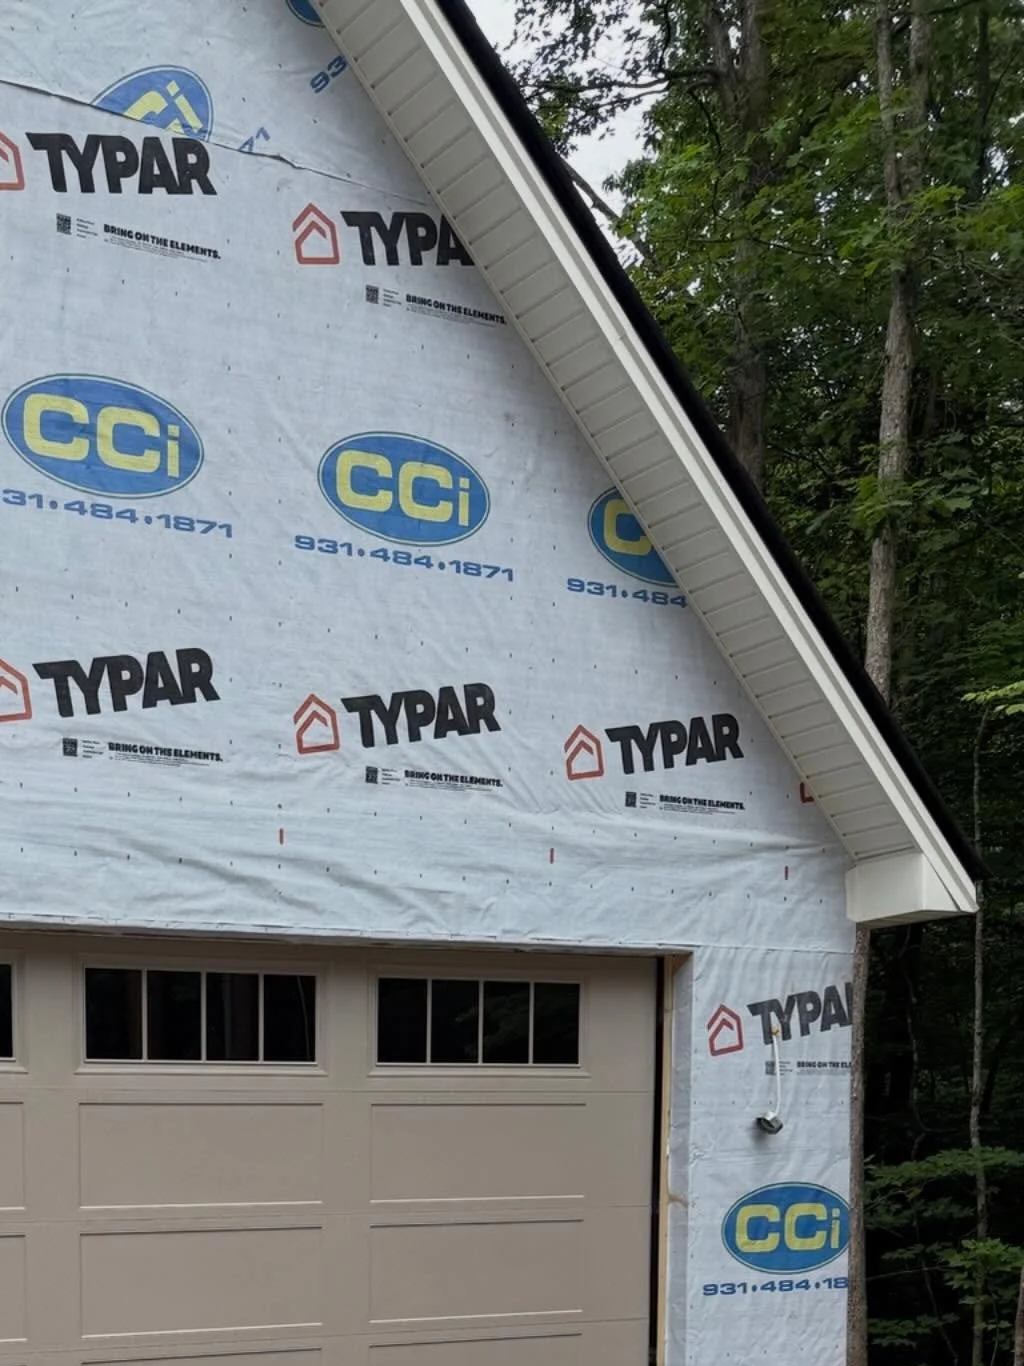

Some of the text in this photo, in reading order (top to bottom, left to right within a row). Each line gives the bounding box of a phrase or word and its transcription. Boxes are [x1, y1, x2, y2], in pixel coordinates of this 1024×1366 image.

[26, 131, 217, 196] TYPAR
[103, 223, 133, 239] BRING
[135, 231, 150, 243] ON
[151, 235, 169, 248] THE
[170, 239, 222, 260] ELEMENTS.
[406, 293, 432, 307] BRING
[433, 300, 446, 311] ON
[446, 303, 462, 314] THE
[463, 307, 507, 325] ELEMENTS.
[22, 393, 181, 478] CCi
[334, 449, 470, 527] CCi
[32, 646, 221, 718] TYPAR
[341, 681, 502, 748] TYPAR
[605, 712, 744, 775] TYPAR
[108, 742, 138, 753] BRING
[139, 746, 153, 755] ON
[154, 747, 172, 757] THE
[173, 749, 223, 762] ELEMENTS.
[404, 769, 430, 780] BRING
[430, 772, 443, 781] ON
[444, 773, 460, 783] THE
[460, 775, 503, 787] ELEMENTS.
[746, 982, 853, 1045] TYPA
[736, 1202, 841, 1253] CCi
